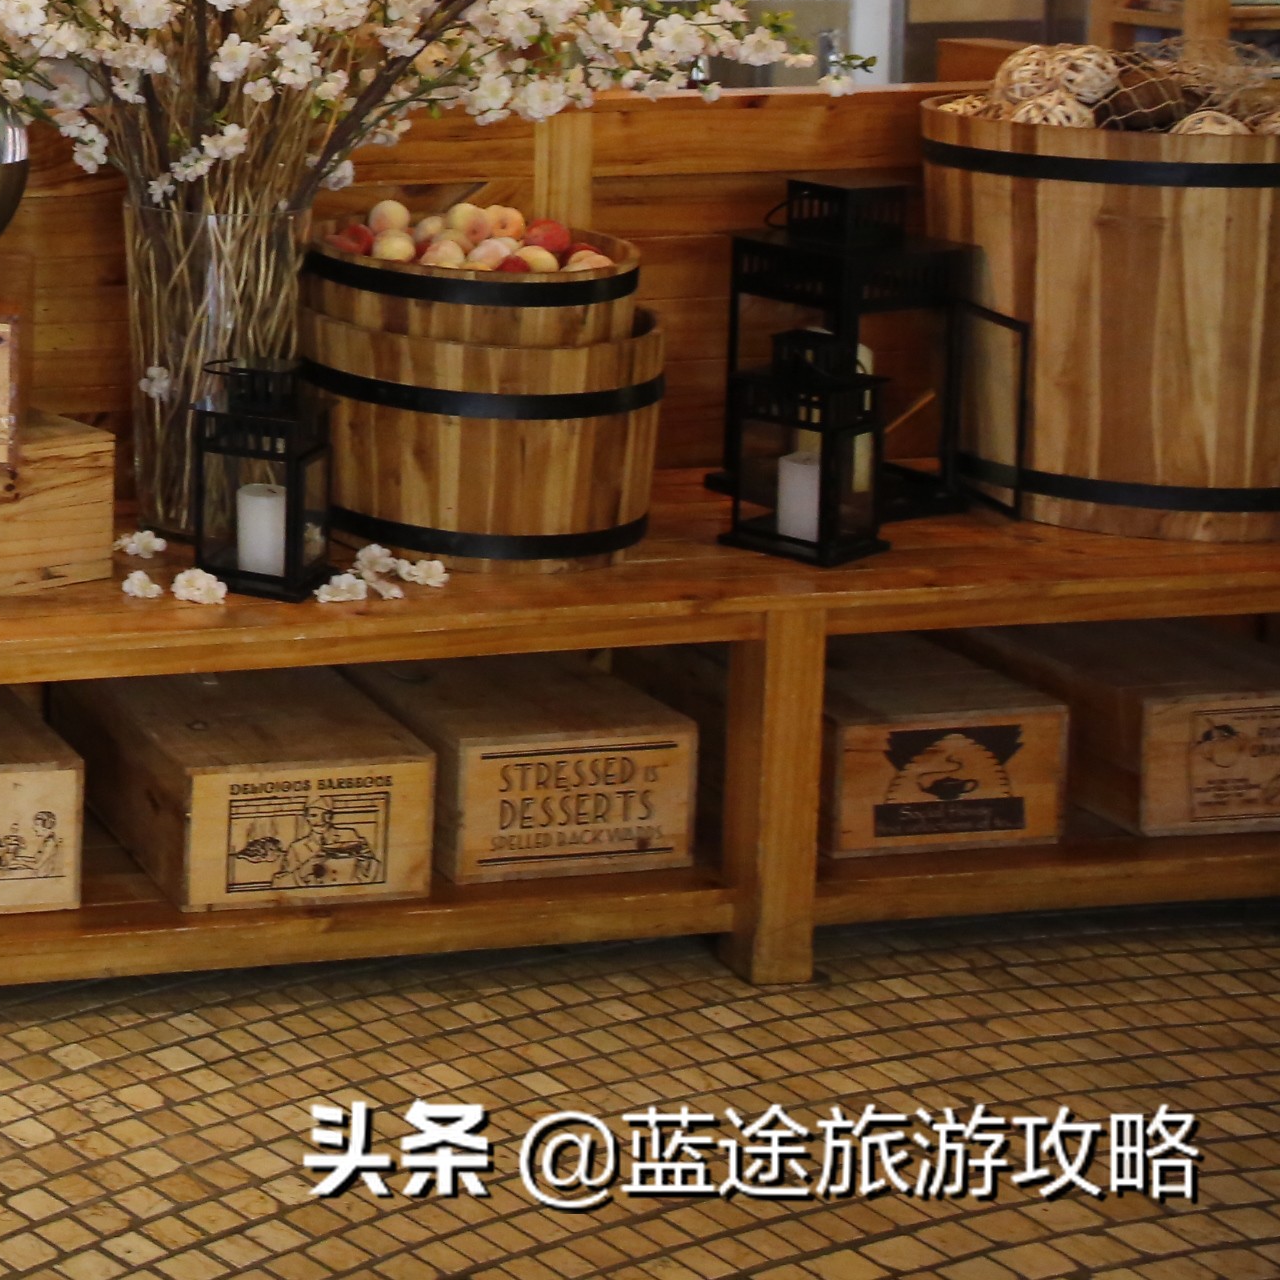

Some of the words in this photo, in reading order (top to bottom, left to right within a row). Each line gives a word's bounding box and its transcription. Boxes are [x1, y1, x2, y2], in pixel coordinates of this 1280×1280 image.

[229, 780, 312, 796] DELICIOUS
[498, 756, 637, 793] STRESSED
[499, 789, 655, 832] DESSERTS
[490, 832, 554, 852] SPELLED
